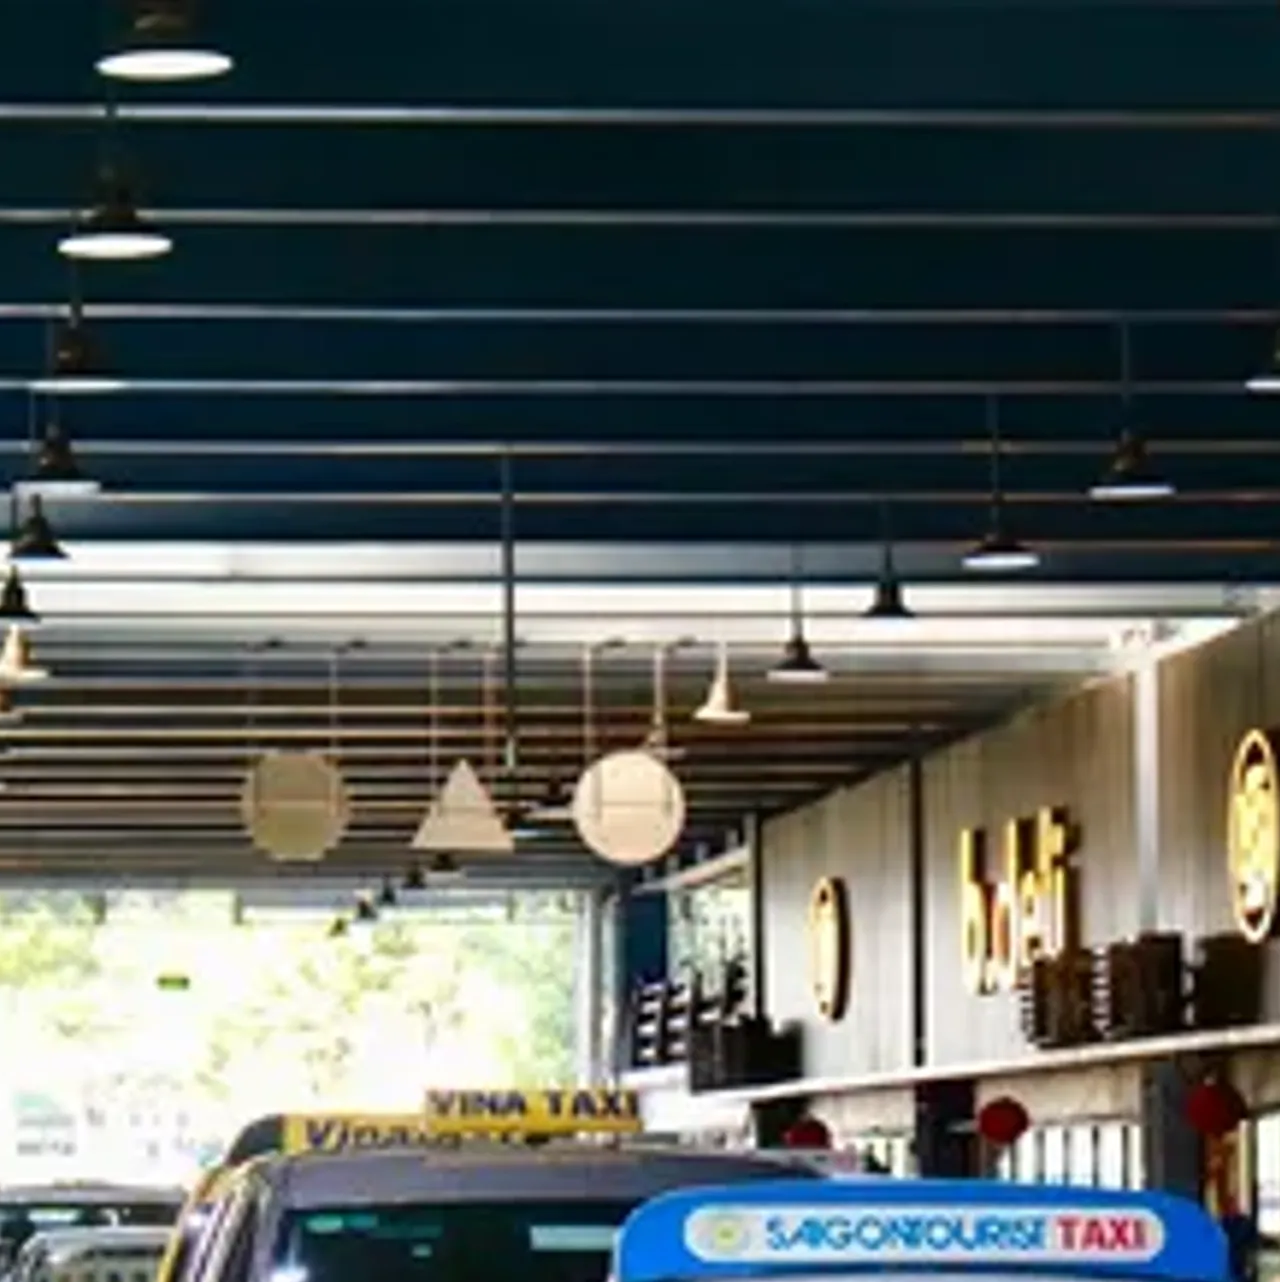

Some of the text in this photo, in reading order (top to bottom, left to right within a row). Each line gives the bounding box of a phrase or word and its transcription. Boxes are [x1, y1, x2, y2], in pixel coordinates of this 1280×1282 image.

[424, 1087, 641, 1119] VINA TAXI
[764, 1215, 1148, 1252] SAIGONTOURIST TAXI
